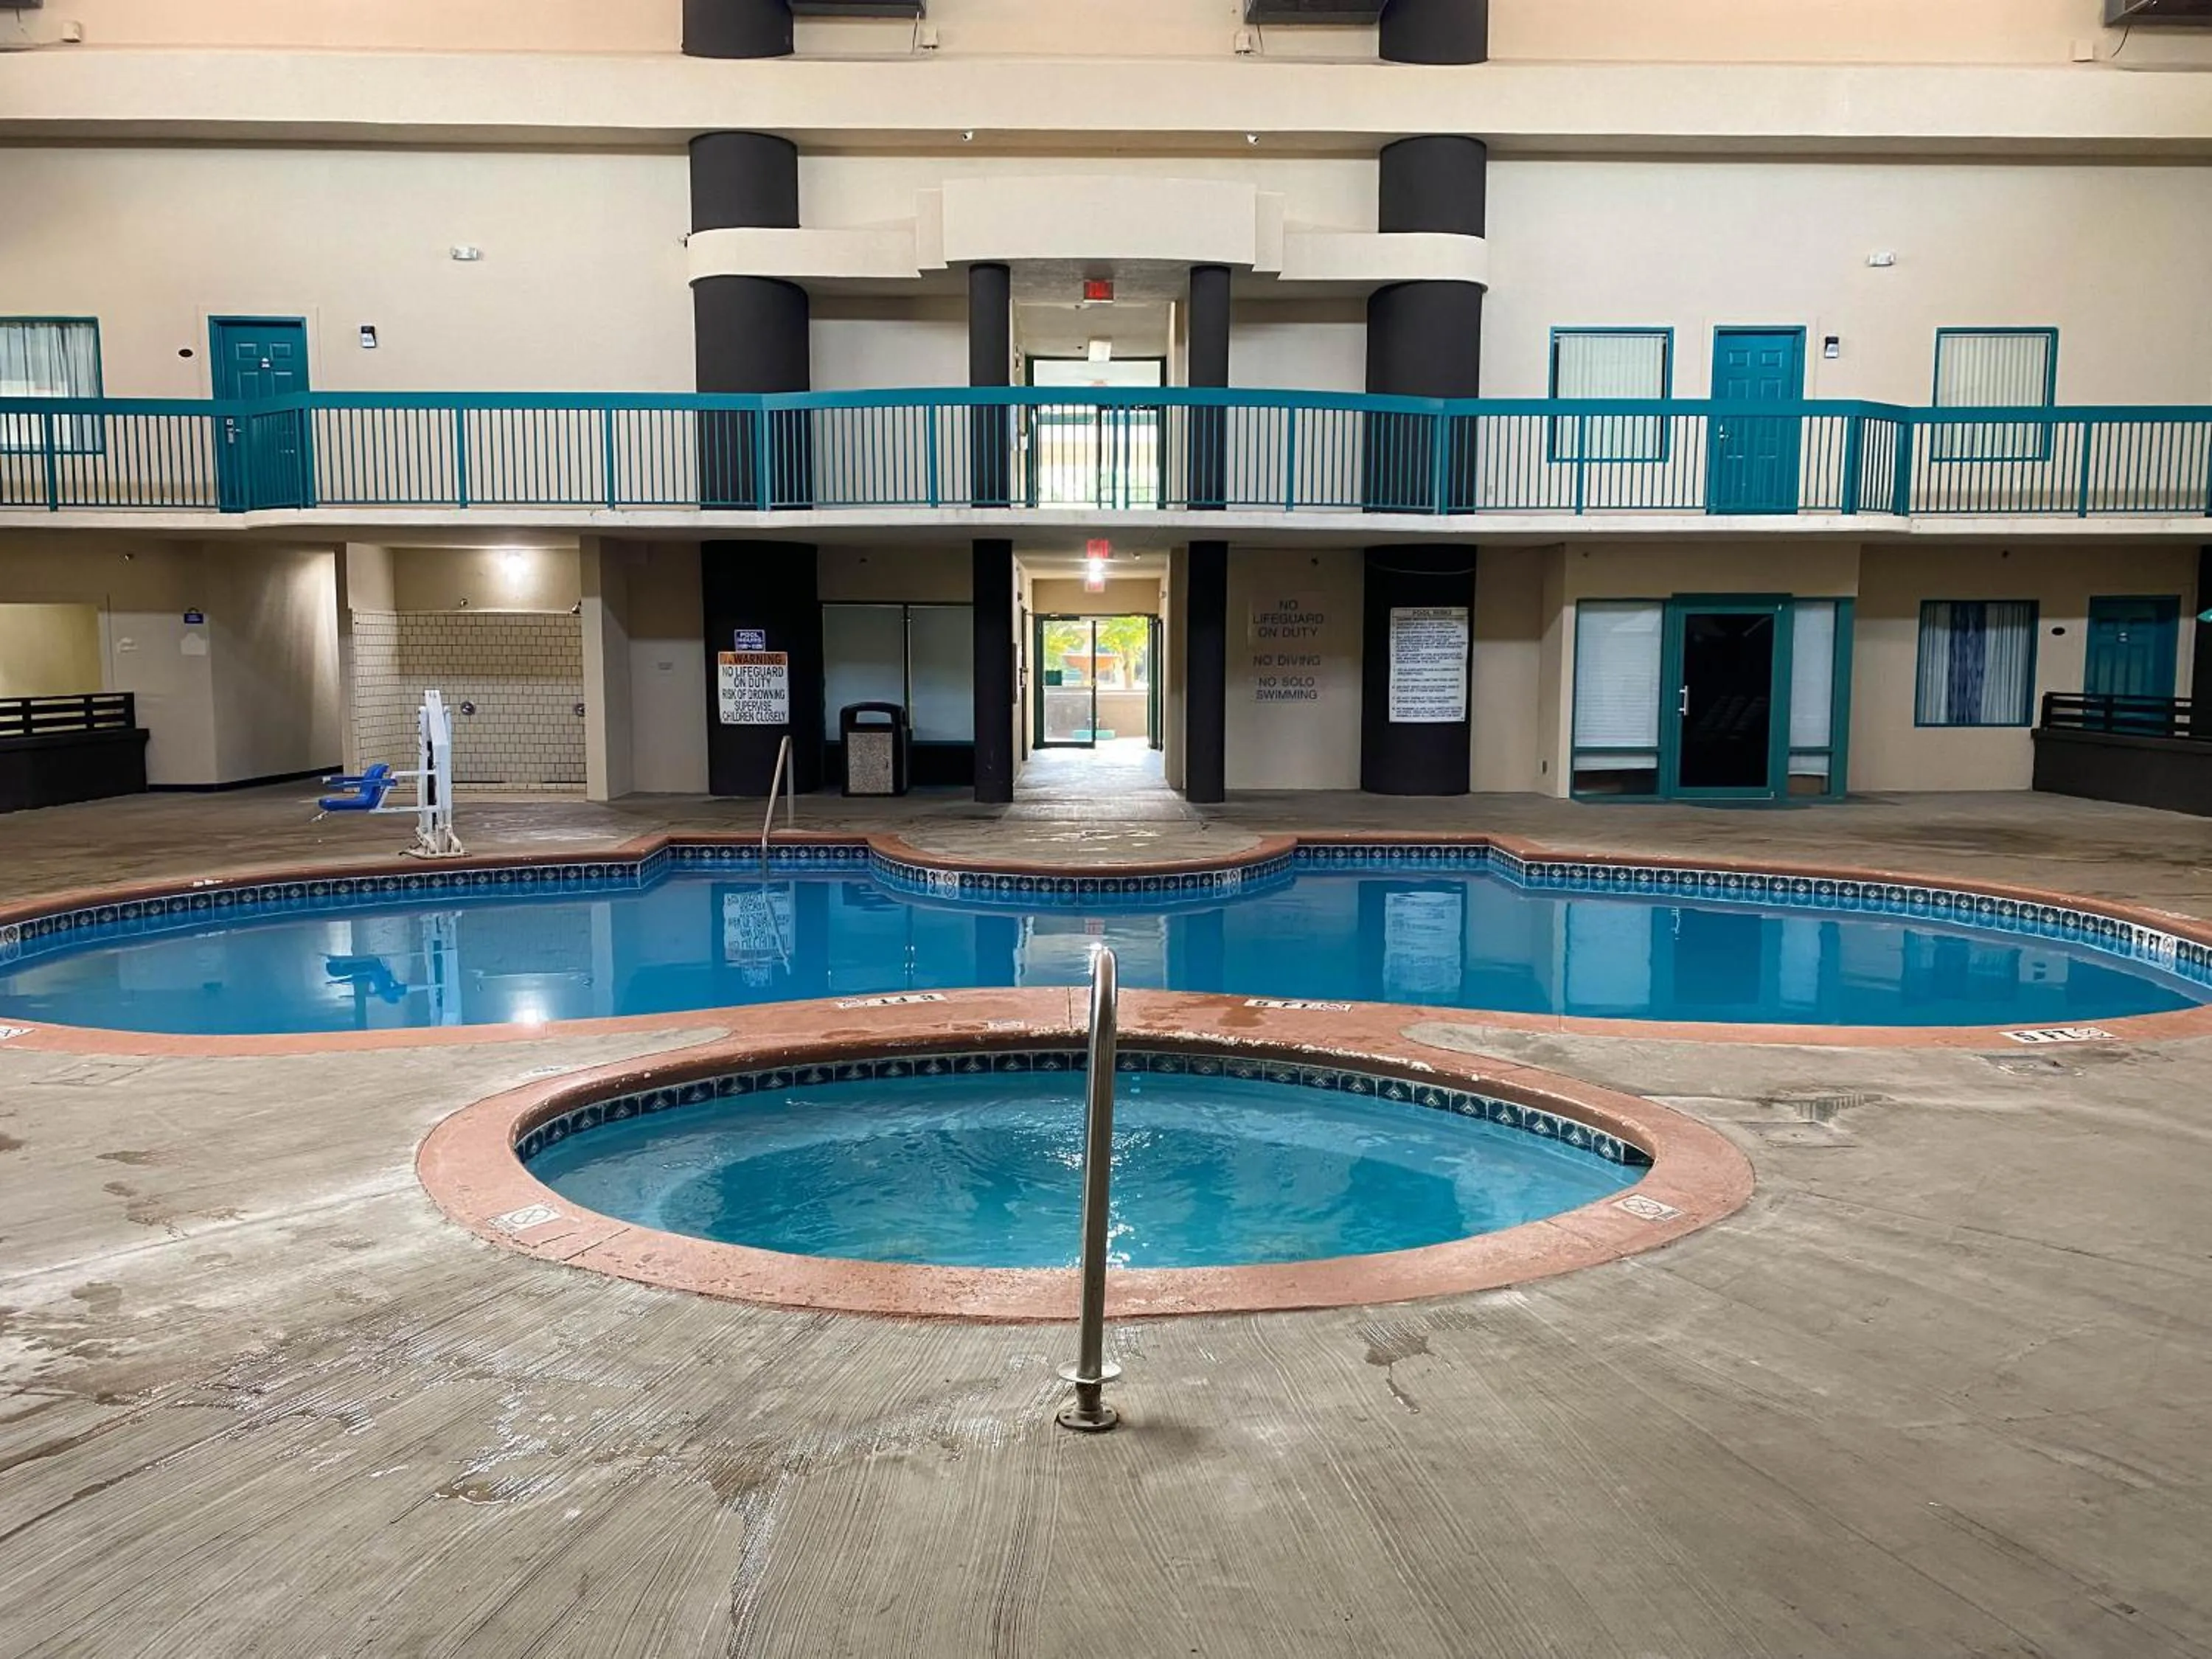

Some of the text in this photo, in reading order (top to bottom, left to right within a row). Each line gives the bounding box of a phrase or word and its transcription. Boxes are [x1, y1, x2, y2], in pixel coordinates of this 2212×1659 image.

[1279, 599, 1298, 611] NO
[1253, 613, 1324, 625] LIFEGUARD
[1258, 627, 1318, 638] ON DUTY
[735, 654, 782, 664] WARNING
[1253, 655, 1321, 666] NO DIVING
[722, 667, 784, 678] NO LIFEGUARD
[734, 678, 772, 688] ON DUTY
[1259, 677, 1315, 687] NO SOLO
[722, 689, 785, 700] RISK OF DROWNING
[1256, 689, 1318, 700] SWIMMING
[734, 700, 772, 712] SUPERVISE
[723, 712, 786, 722] CHILDREN CLOSELY
